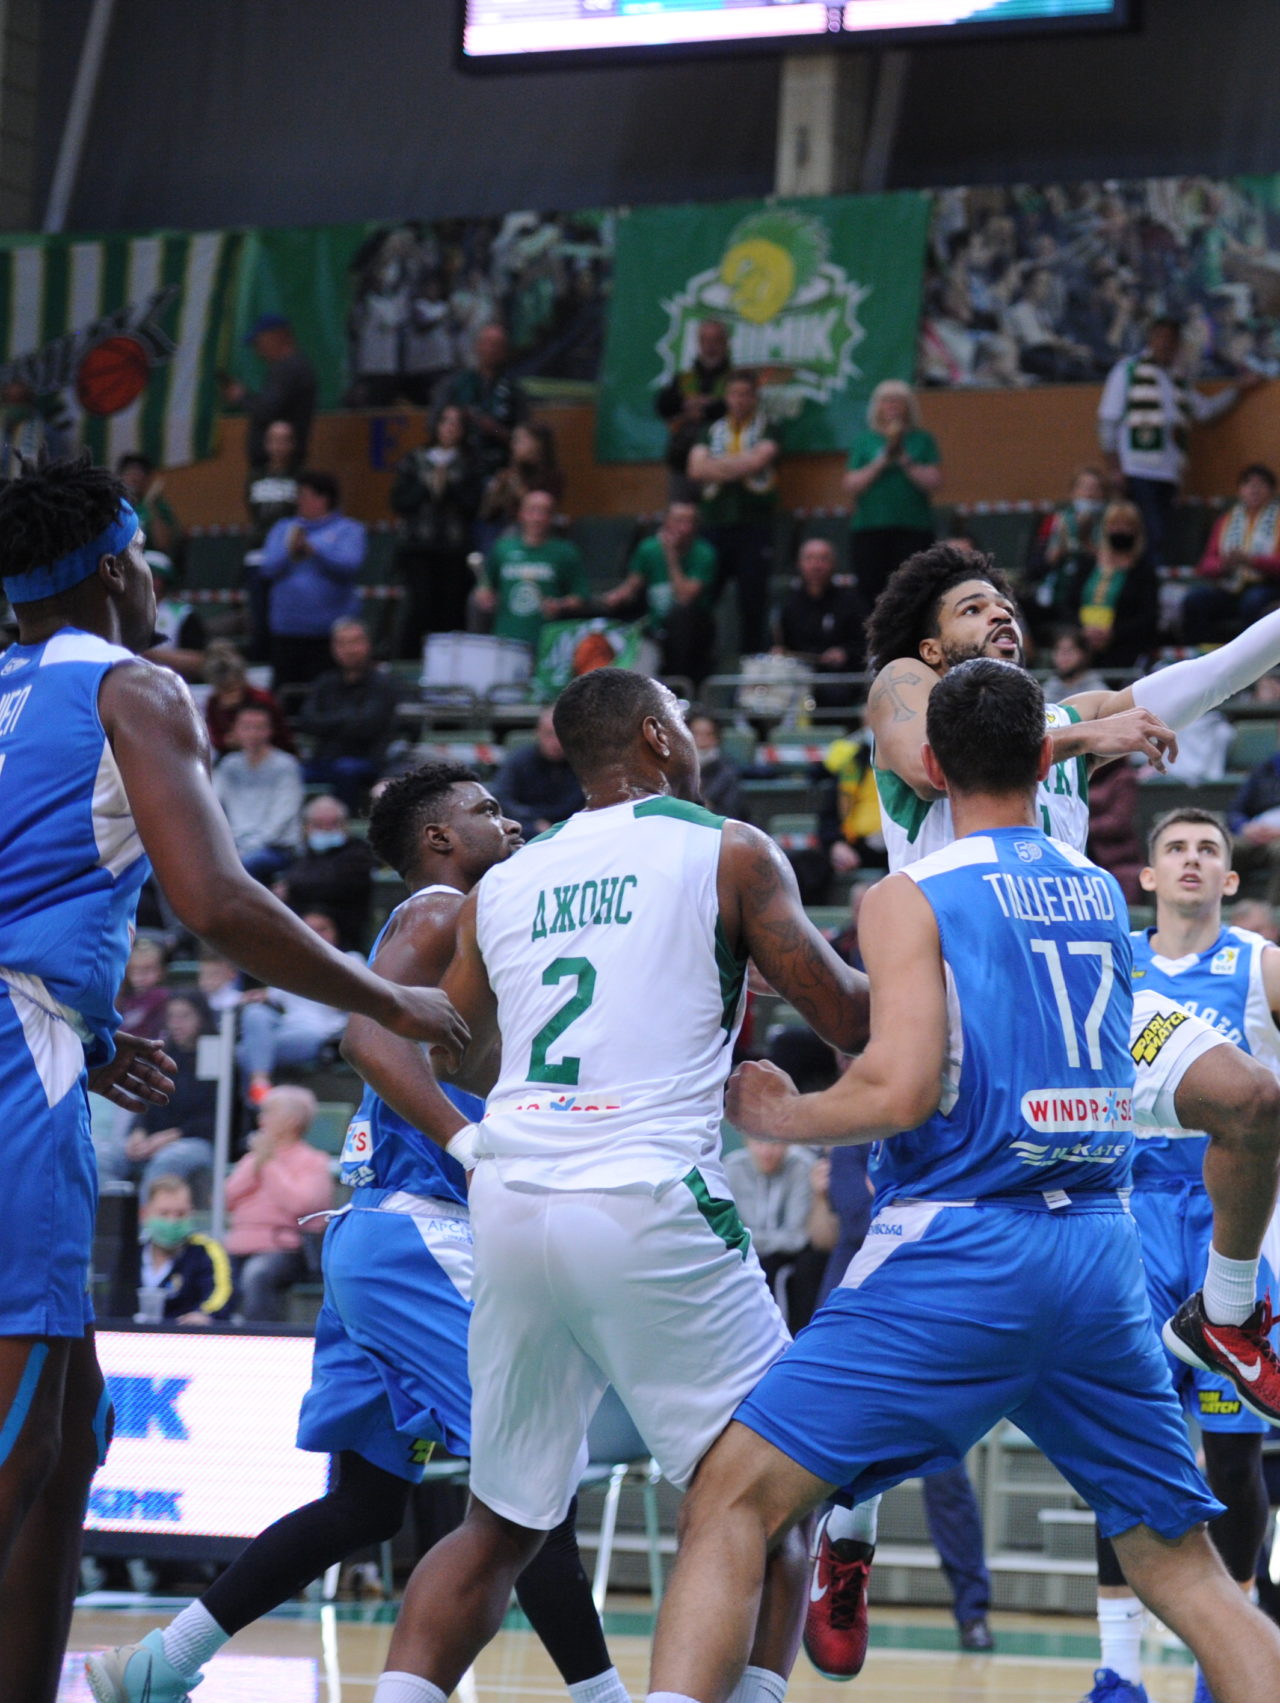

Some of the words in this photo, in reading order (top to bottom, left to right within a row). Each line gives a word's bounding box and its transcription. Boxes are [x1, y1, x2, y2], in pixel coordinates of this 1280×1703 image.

[531, 874, 638, 943] ДЖОНС
[982, 872, 1115, 926] ТІЩЕНКО
[524, 956, 598, 1086] 2
[1029, 938, 1116, 1070] 17
[1131, 1014, 1165, 1062] PARI
